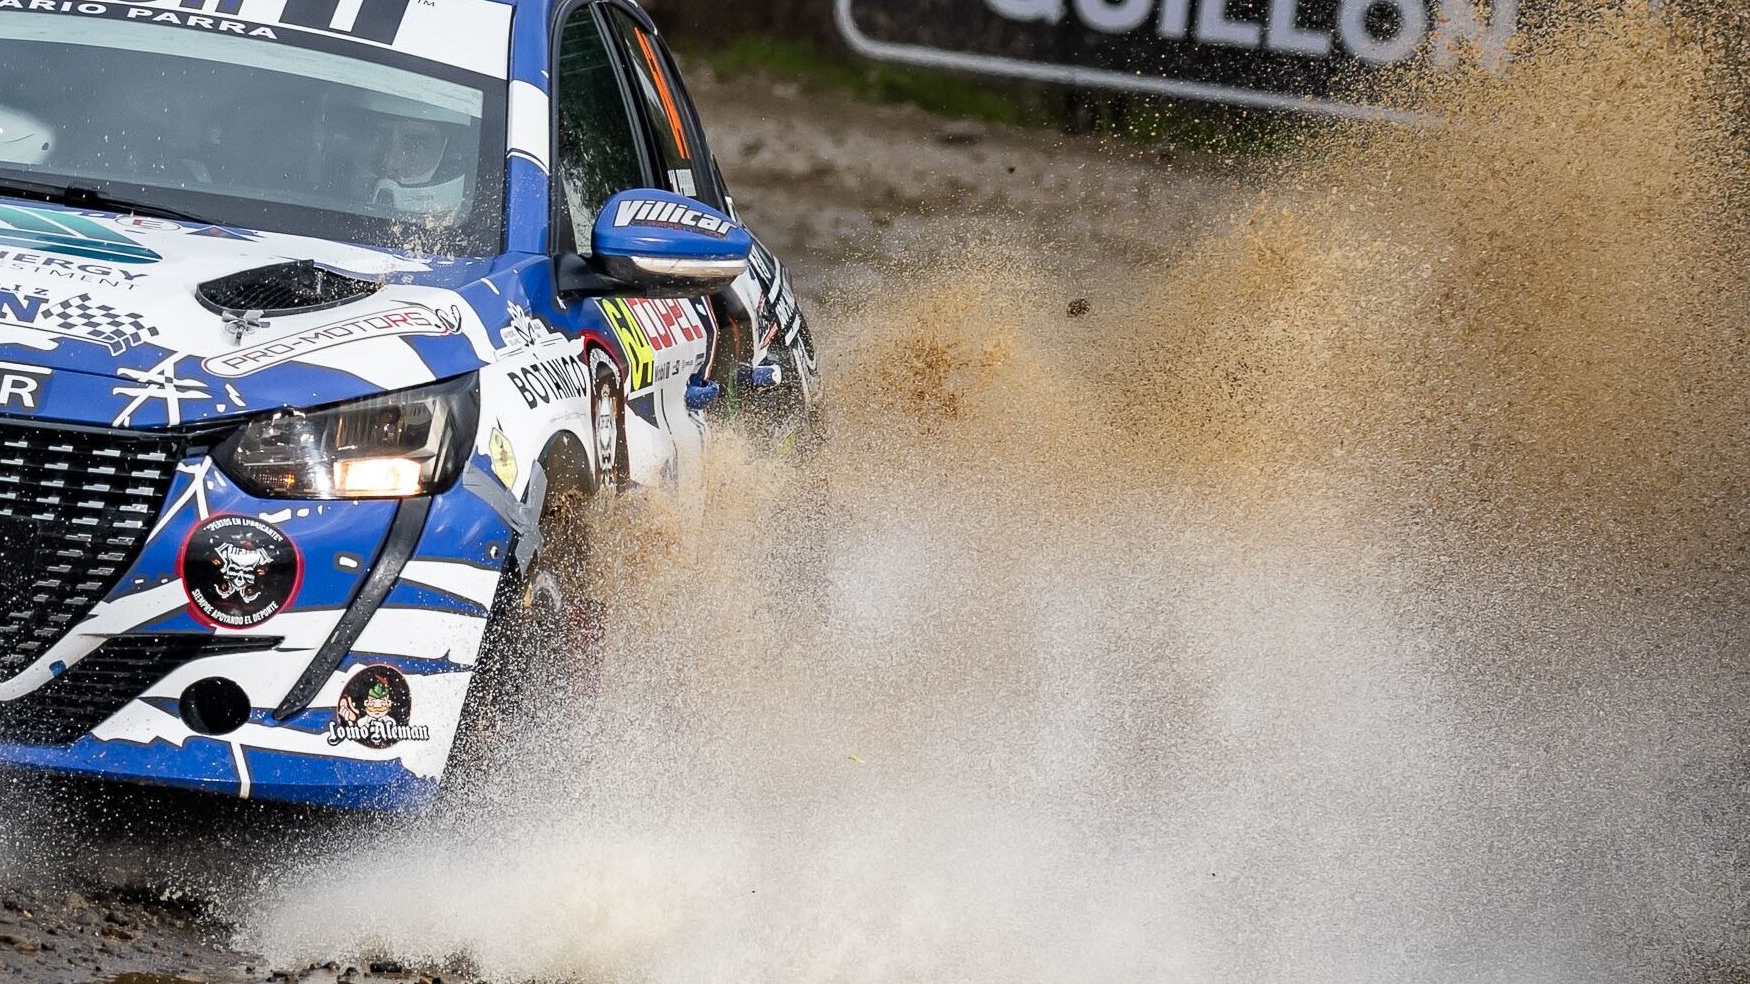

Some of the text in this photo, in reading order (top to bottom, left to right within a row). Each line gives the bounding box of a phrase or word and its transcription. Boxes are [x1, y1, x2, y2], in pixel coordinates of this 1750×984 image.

[126, 6, 279, 40] PARRA
[613, 200, 738, 235] Villicar
[221, 310, 436, 371] PRO-MOTORS
[191, 588, 215, 615] SIEMPRE
[327, 721, 431, 745] Lomo Aleman
